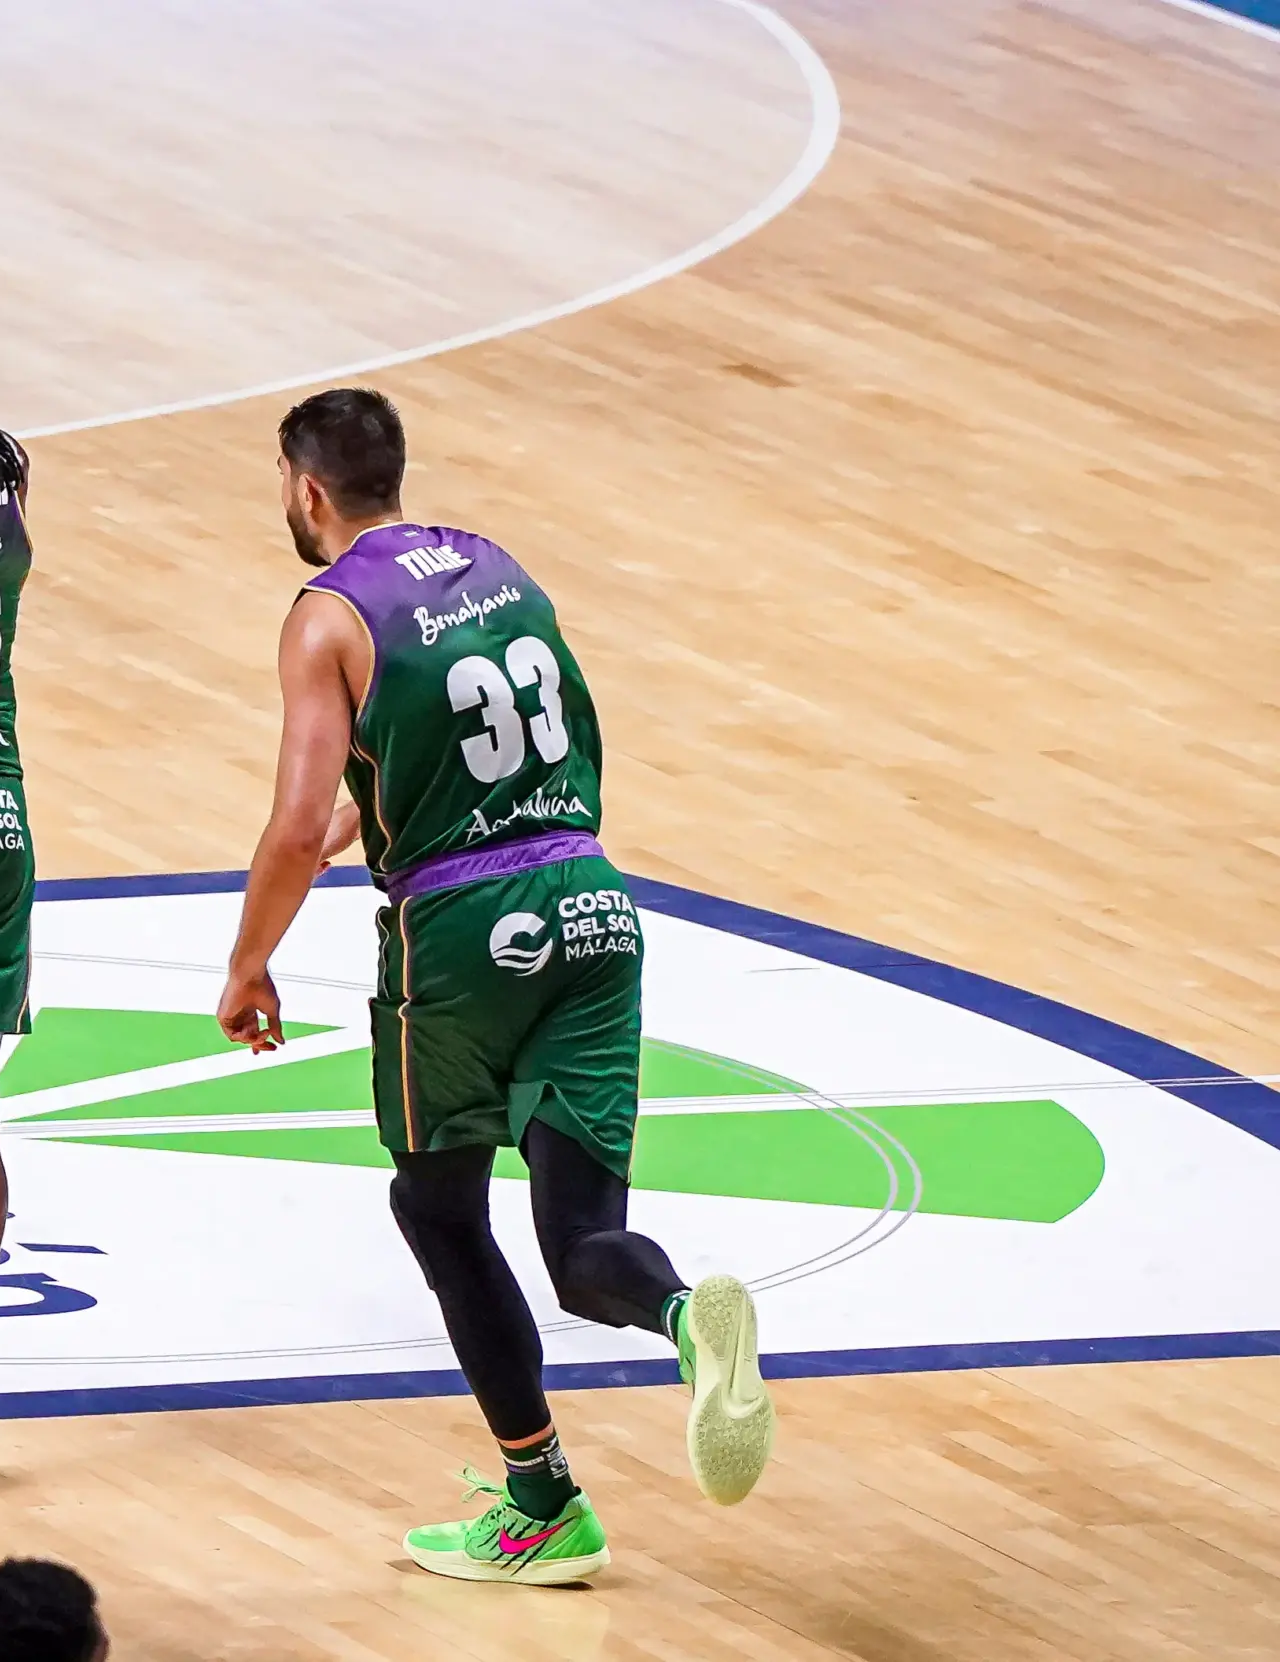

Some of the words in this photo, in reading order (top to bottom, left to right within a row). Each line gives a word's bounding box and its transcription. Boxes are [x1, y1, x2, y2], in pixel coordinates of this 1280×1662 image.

[446, 636, 570, 783] 33
[558, 889, 635, 919] COSTA
[562, 917, 606, 942] DEL
[607, 913, 639, 936] SOL
[565, 935, 638, 962] MÁLAGA
